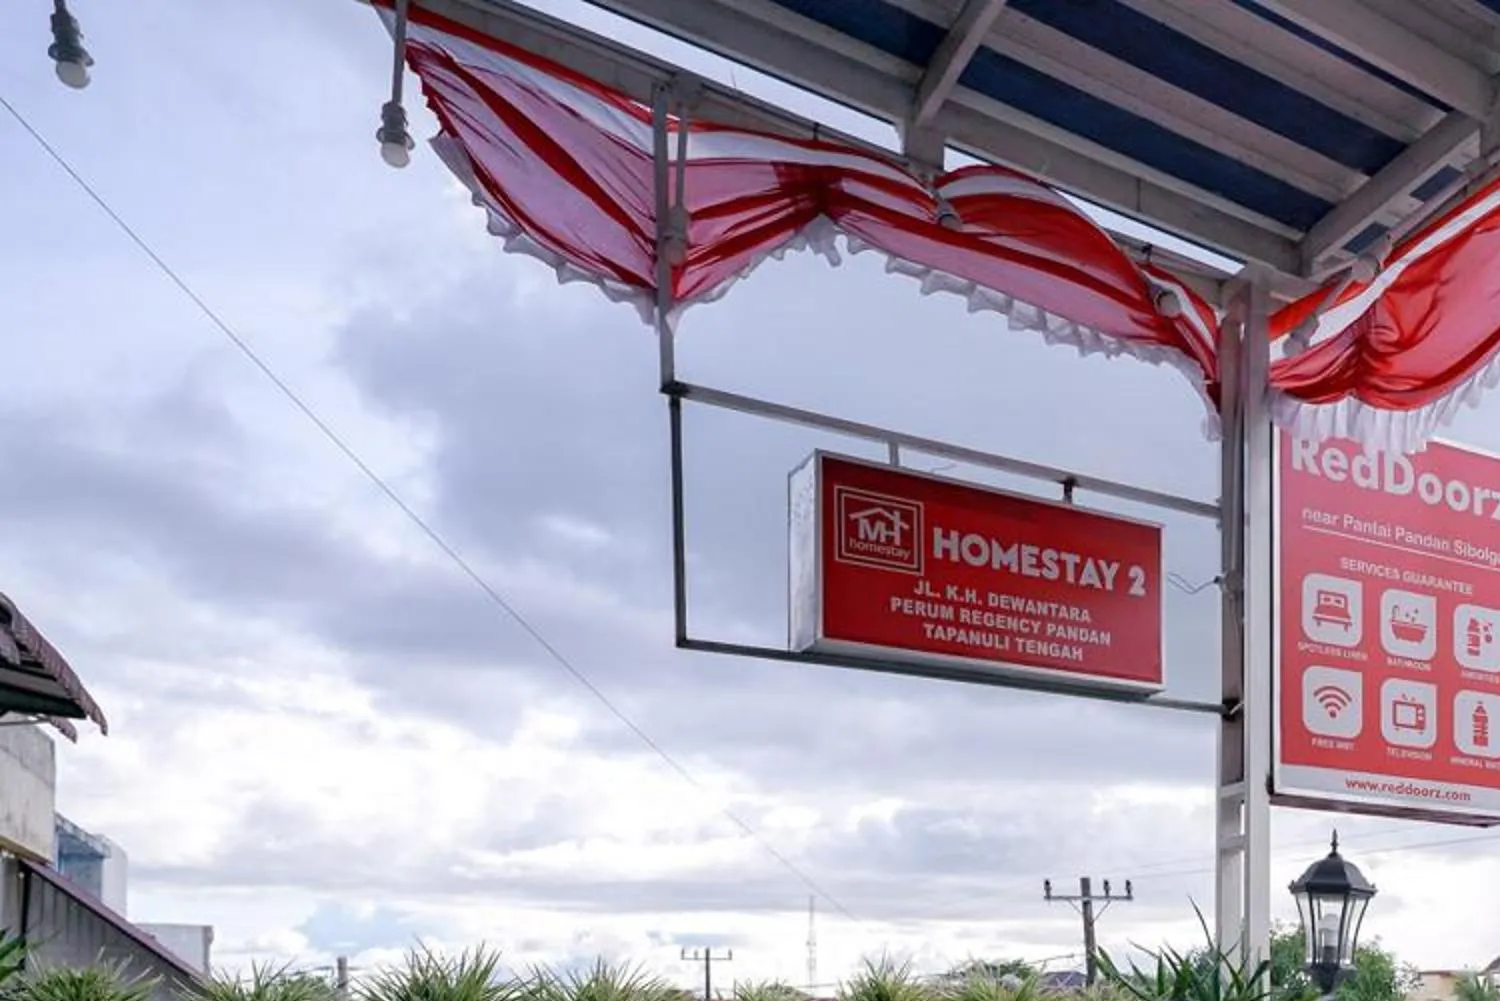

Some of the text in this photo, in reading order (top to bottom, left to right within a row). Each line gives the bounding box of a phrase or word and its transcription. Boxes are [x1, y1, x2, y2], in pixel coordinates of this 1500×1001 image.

[849, 537, 911, 560] homestay
[1302, 508, 1338, 525] near
[1395, 527, 1449, 550] Pandan
[933, 527, 1147, 596] HOMESTAY 2
[1340, 557, 1473, 595] SERVICES GUARANTEE
[891, 597, 1111, 647] PERUM REGENCY PANDAN
[914, 580, 1091, 624] JL. K.H. DEWANTARA
[924, 623, 1084, 662] TAPANULI TENGAH
[1344, 777, 1471, 802] www.reddoorz.com
